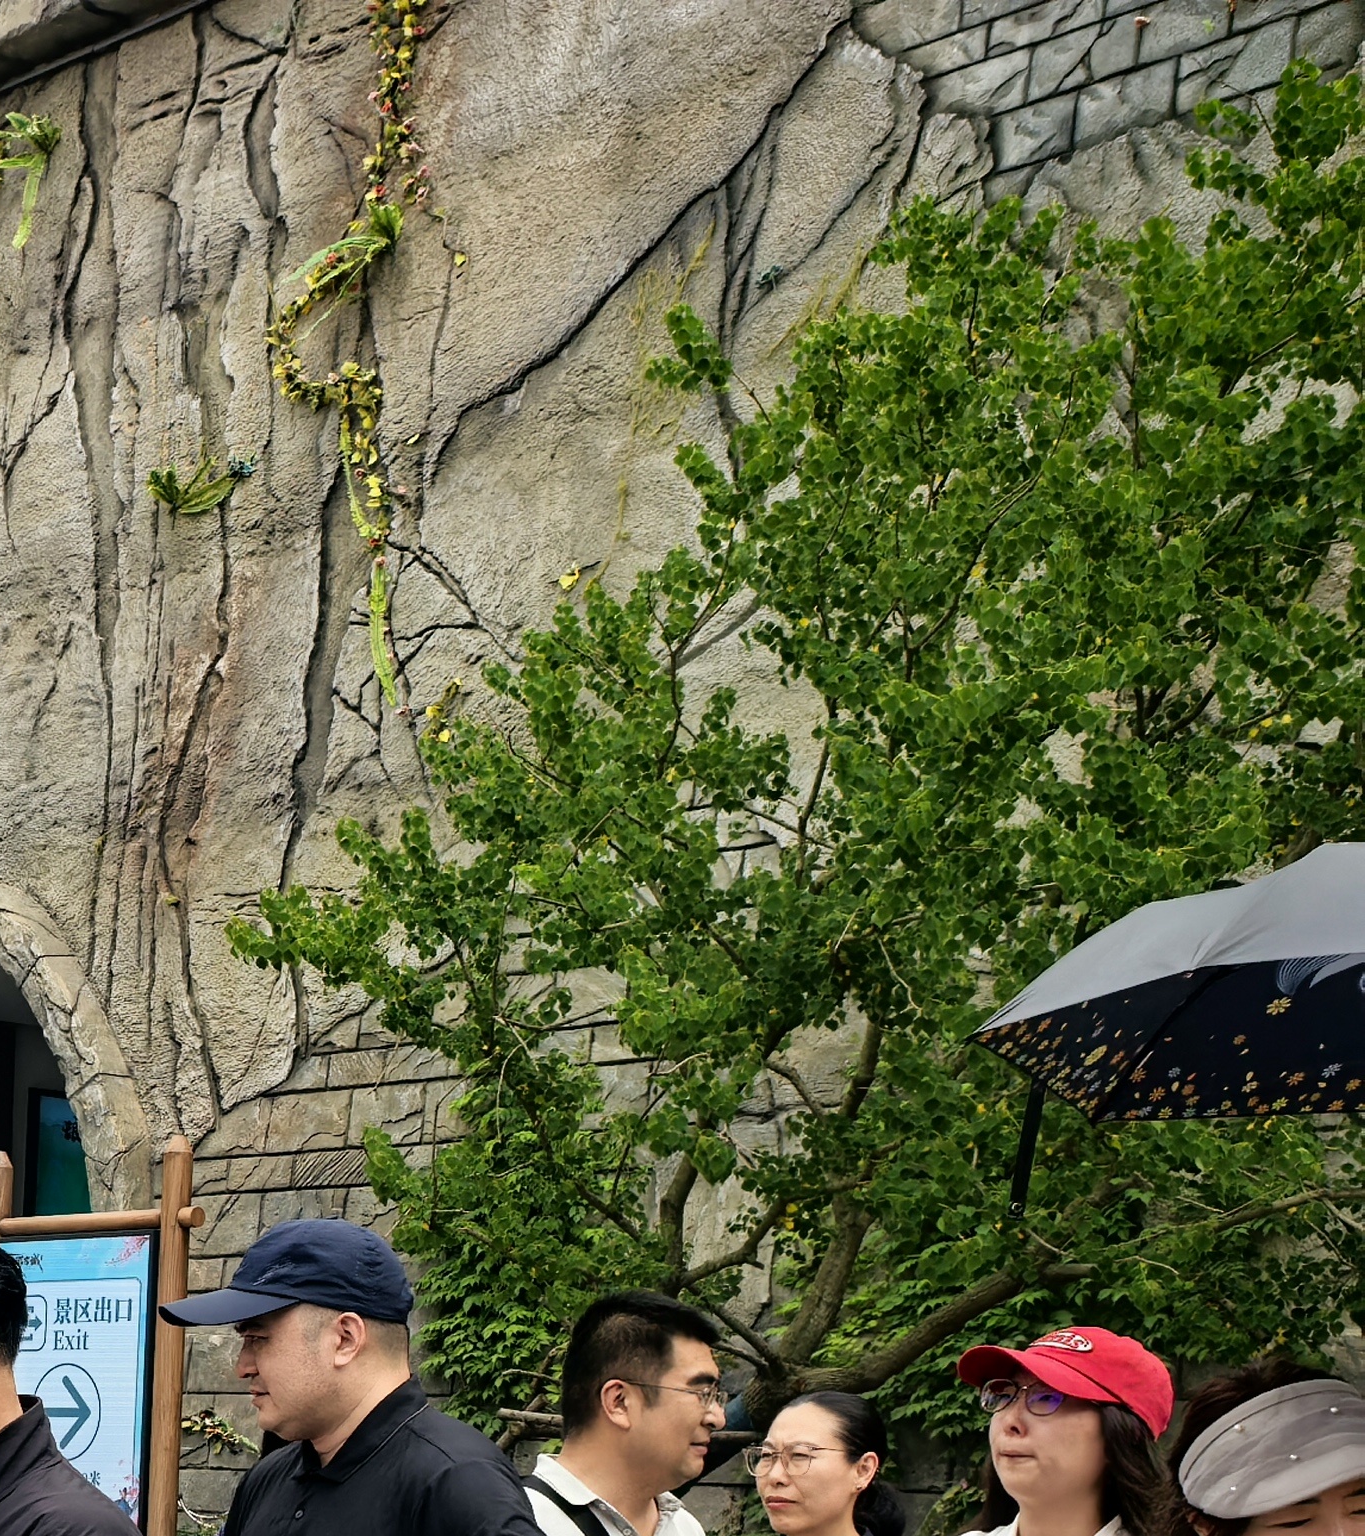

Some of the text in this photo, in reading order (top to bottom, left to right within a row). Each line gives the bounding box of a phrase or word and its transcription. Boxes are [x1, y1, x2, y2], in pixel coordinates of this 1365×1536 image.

[53, 1296, 133, 1325] 景区出口
[52, 1328, 90, 1352] Exit
